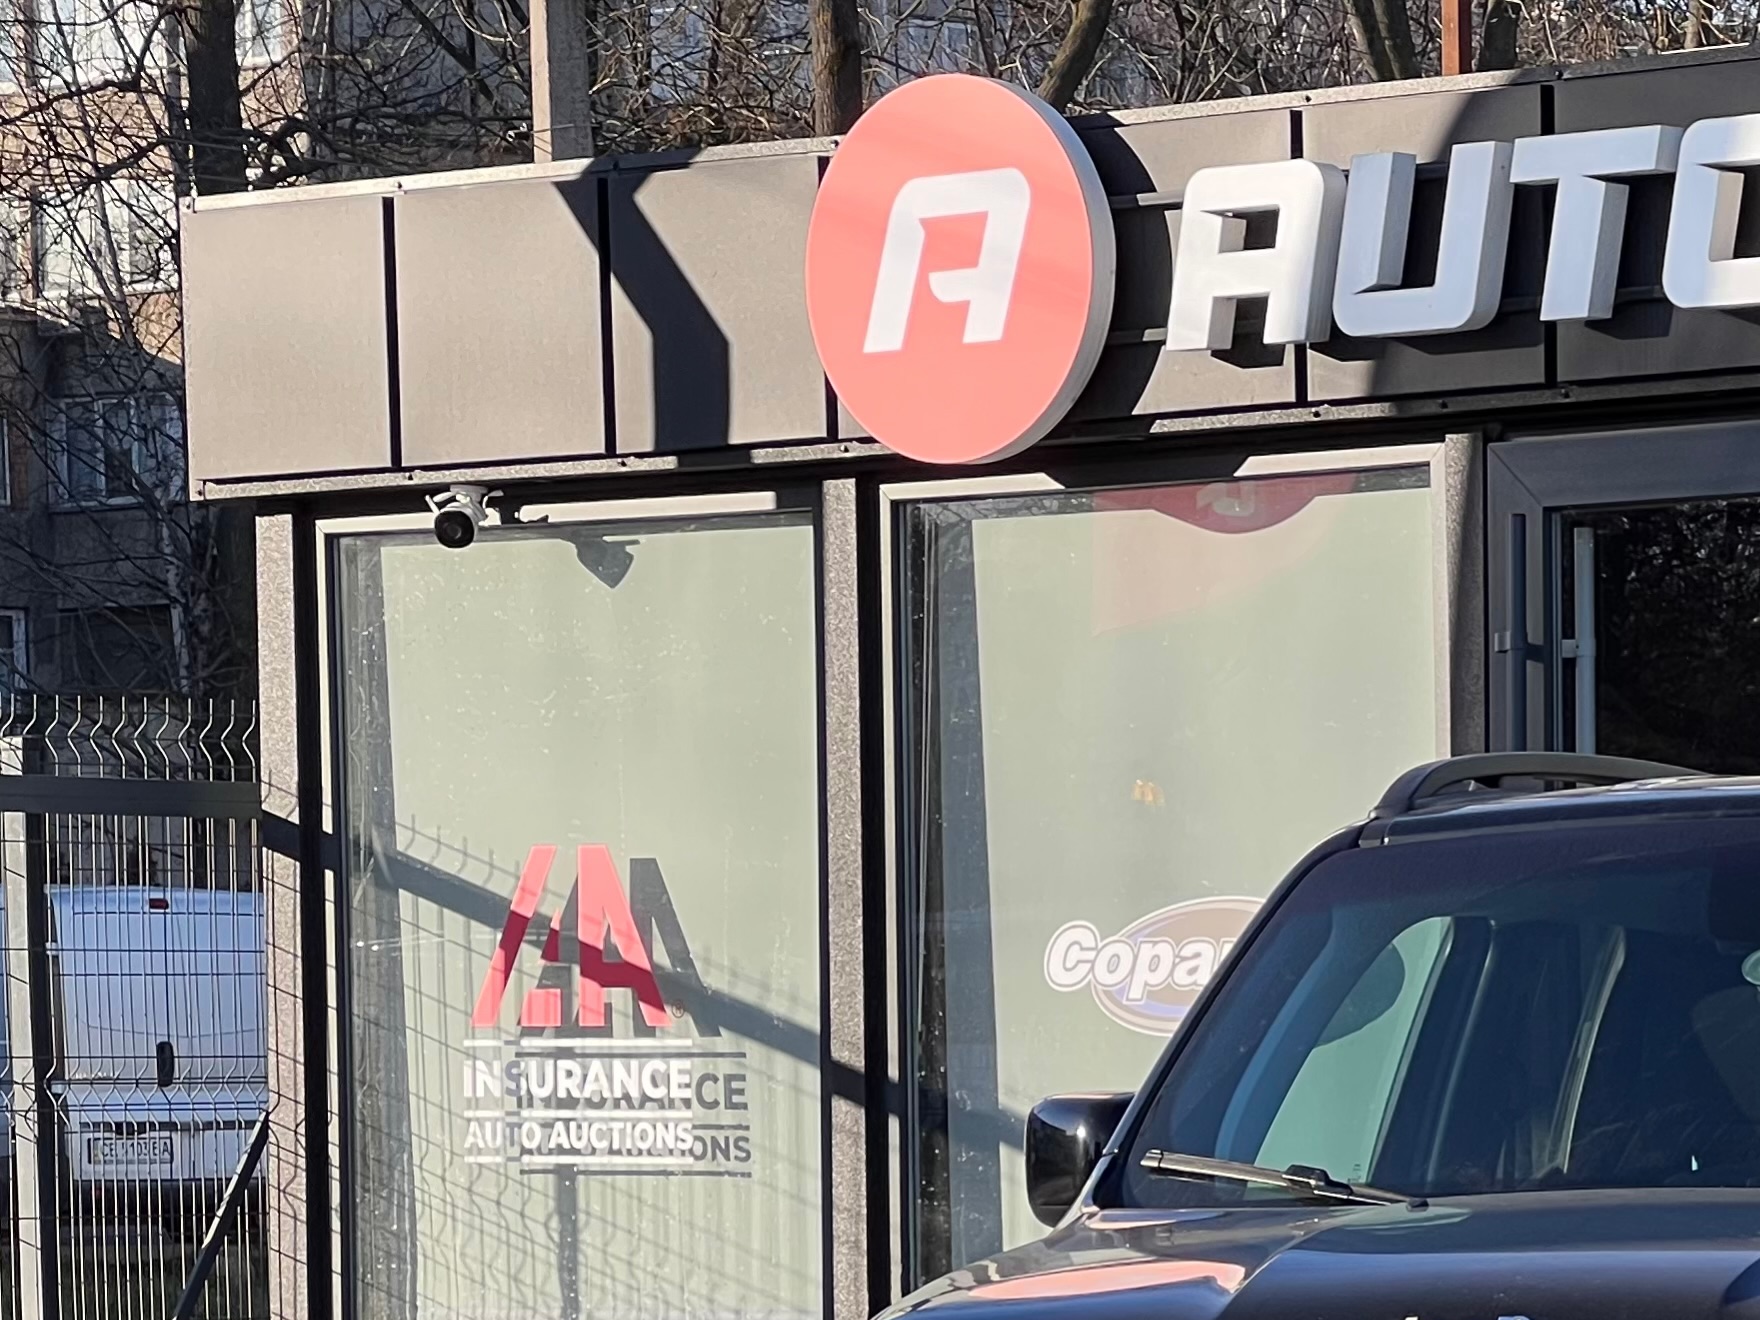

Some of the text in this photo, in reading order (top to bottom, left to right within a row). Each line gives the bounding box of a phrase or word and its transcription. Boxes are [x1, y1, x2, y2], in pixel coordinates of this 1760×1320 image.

[462, 1059, 693, 1099] INSURANCE
[463, 1121, 542, 1150] AUTO
[548, 1120, 695, 1150] AUCTIONS
